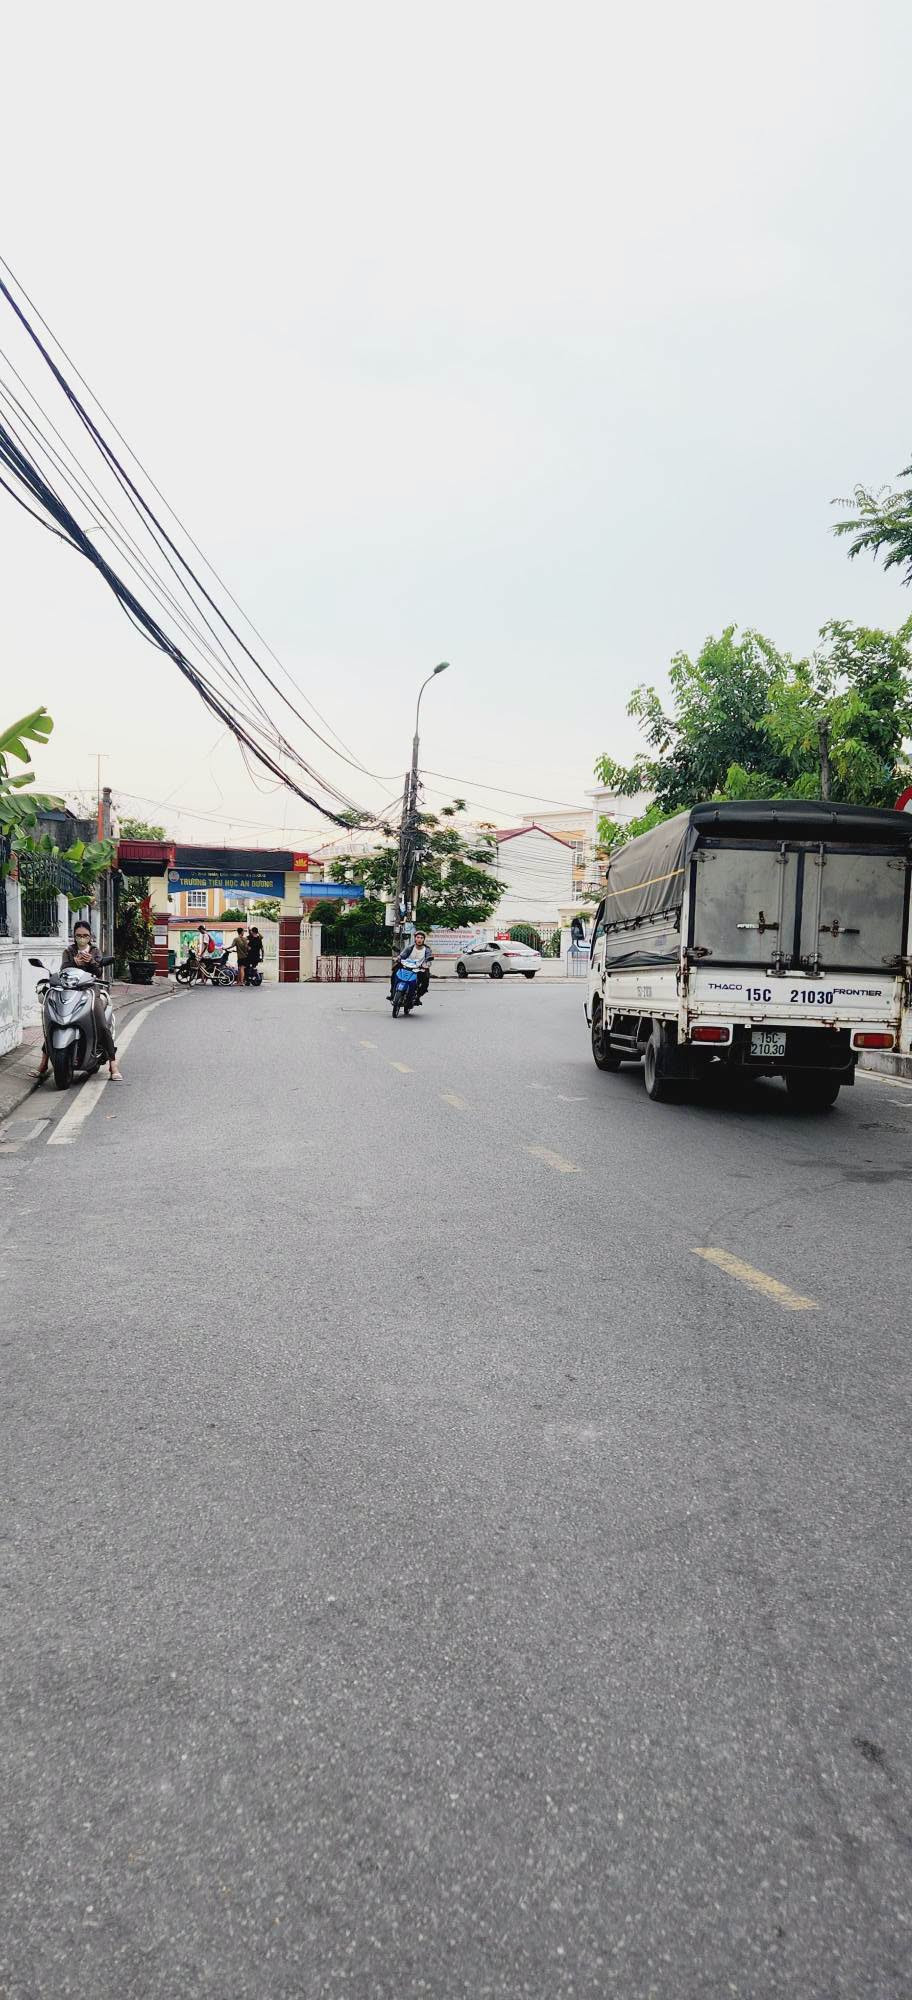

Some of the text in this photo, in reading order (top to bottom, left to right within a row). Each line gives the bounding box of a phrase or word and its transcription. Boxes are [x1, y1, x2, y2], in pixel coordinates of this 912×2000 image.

[708, 983, 743, 991] THACO
[745, 988, 834, 1005] 15C 21030
[833, 988, 882, 997] FRONTIER
[751, 1043, 785, 1055] 210.30
